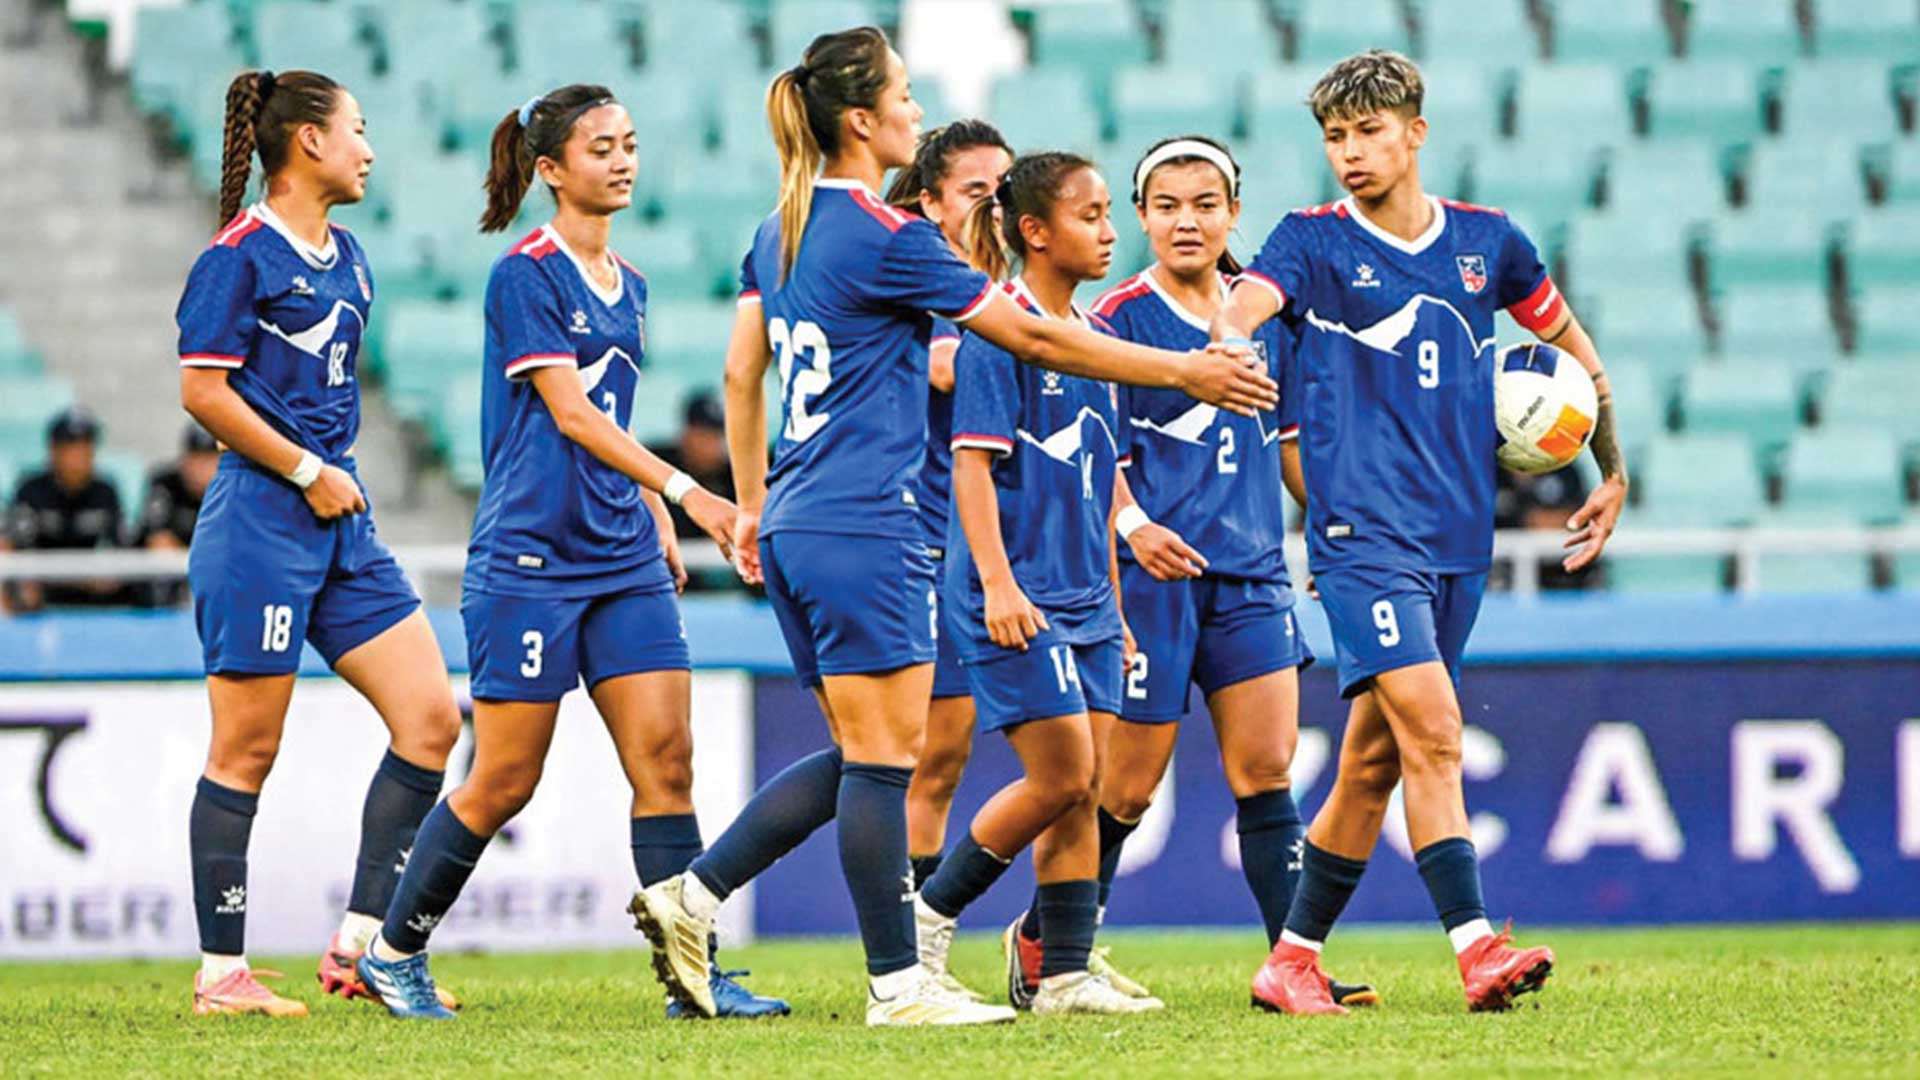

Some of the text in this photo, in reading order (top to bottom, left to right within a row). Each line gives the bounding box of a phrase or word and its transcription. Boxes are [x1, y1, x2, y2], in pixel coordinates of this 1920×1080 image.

[327, 342, 349, 387] 18
[768, 317, 831, 442] 22
[1418, 340, 1439, 389] 9
[1217, 426, 1239, 474] 2
[261, 604, 293, 652] 18
[1371, 599, 1401, 648] 9
[521, 630, 543, 678] 3
[1049, 645, 1081, 693] 14
[1127, 652, 1149, 699] 2
